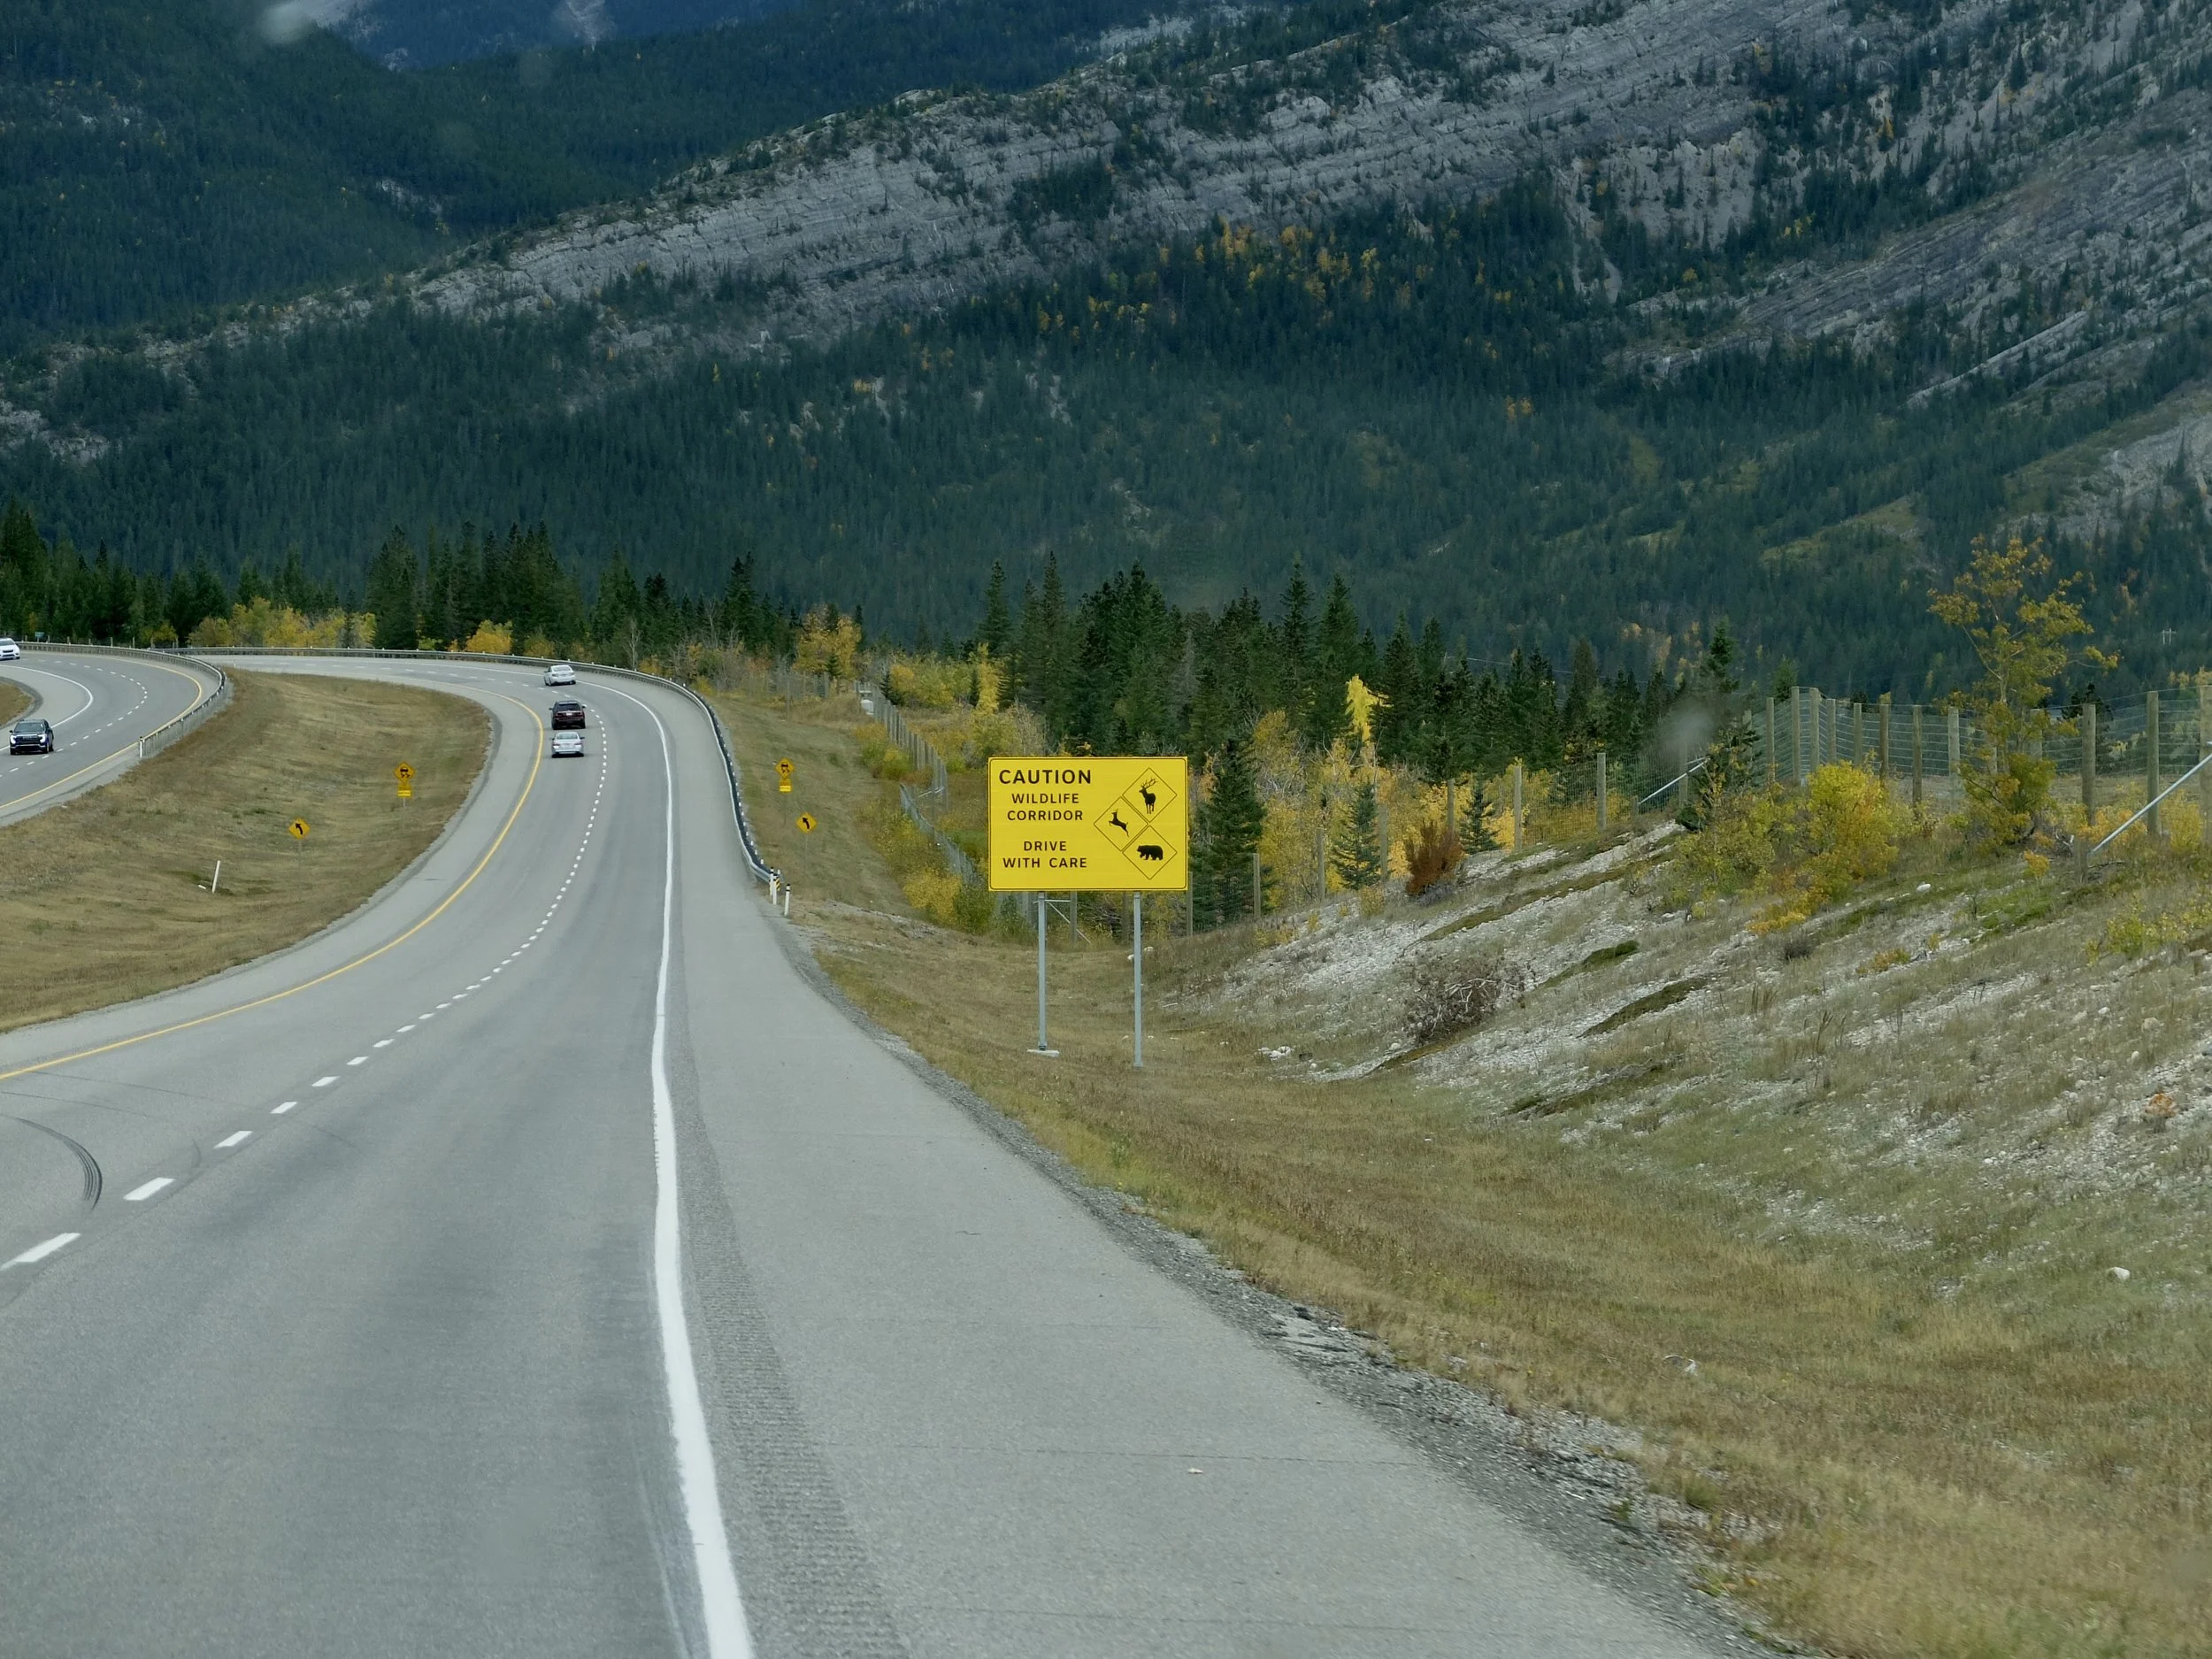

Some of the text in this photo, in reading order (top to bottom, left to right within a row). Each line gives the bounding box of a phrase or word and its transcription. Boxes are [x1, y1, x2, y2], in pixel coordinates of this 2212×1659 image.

[999, 769, 1091, 784] CAUTION
[1011, 793, 1079, 804] WILDLIFE
[1007, 810, 1083, 821] CORRIDOR
[1024, 841, 1067, 851] DRIVE
[1002, 857, 1087, 868] WITH CARE
